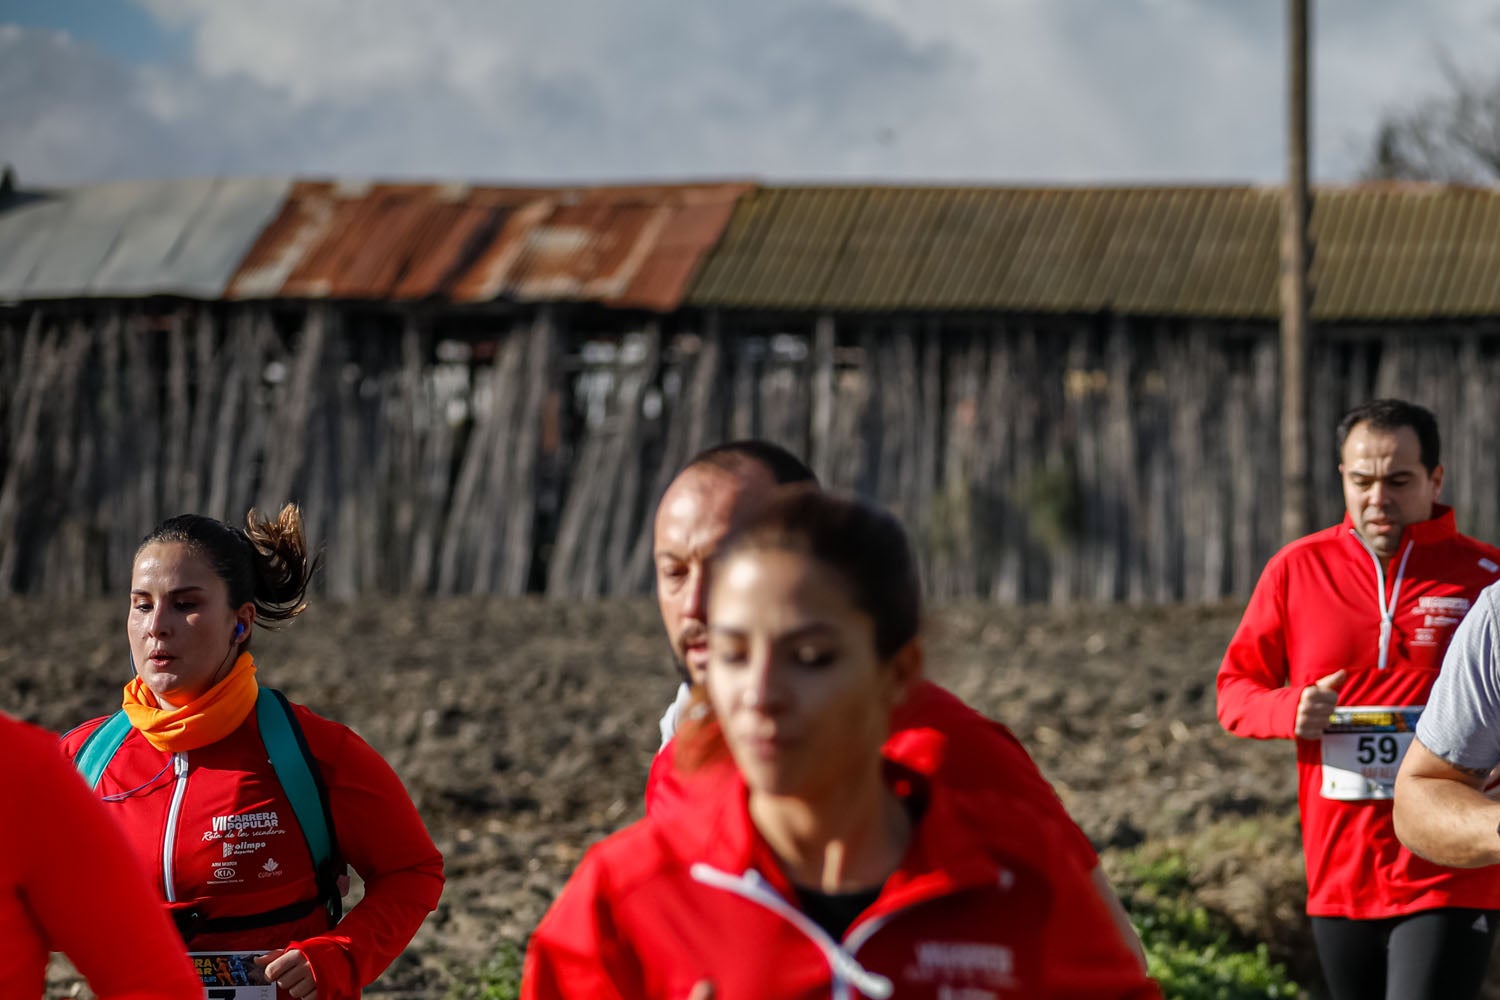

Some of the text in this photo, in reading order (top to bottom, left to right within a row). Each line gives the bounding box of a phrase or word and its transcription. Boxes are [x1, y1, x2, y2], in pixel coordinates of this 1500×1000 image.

[1357, 735, 1398, 765] 59
[212, 812, 278, 831] VII CARRERA
[227, 820, 278, 830] POPULAR
[224, 830, 235, 839] de
[235, 842, 266, 852] olimpo
[217, 869, 232, 877] KIA
